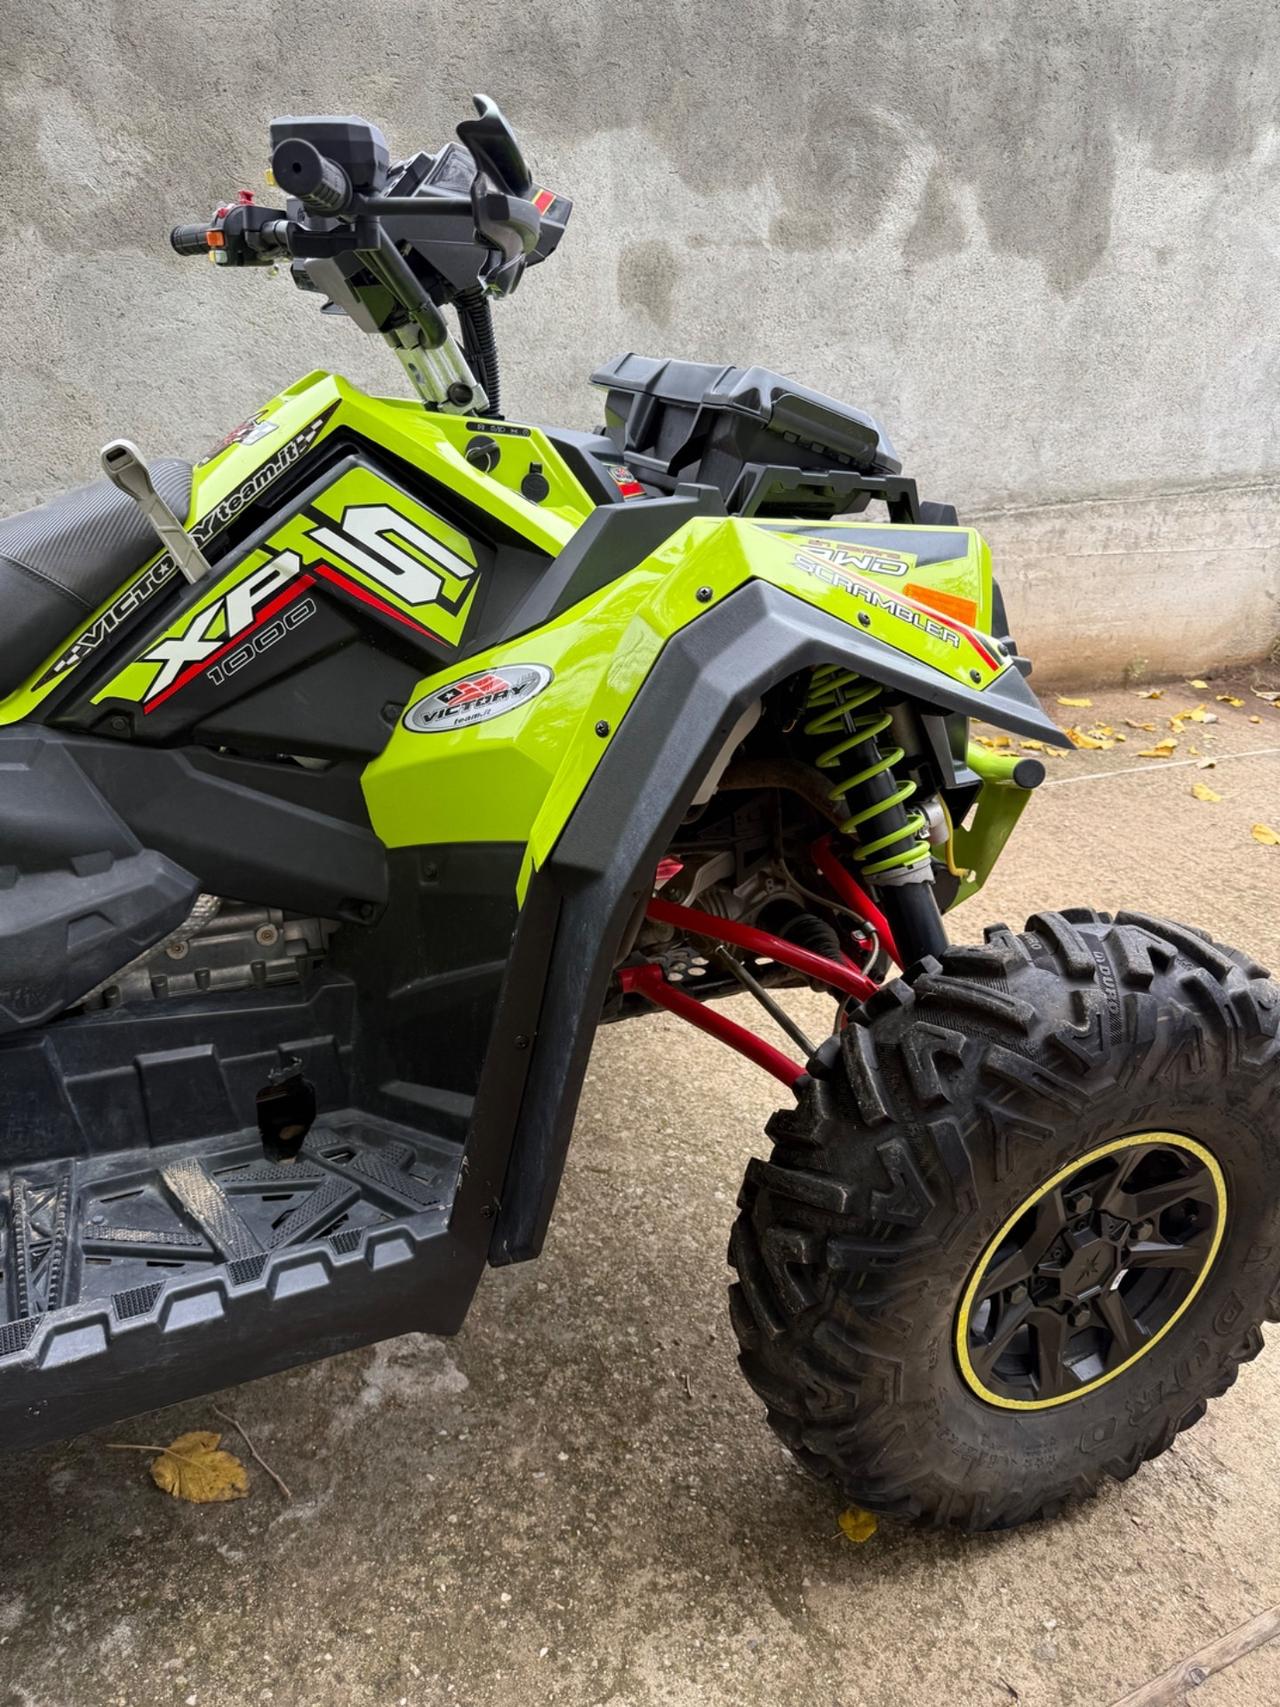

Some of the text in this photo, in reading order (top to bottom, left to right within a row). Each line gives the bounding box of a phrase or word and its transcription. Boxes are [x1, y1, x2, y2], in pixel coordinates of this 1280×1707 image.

[207, 598, 316, 685] 1000
[791, 553, 960, 649] SCRAMBLER
[421, 684, 528, 724] VICTORY
